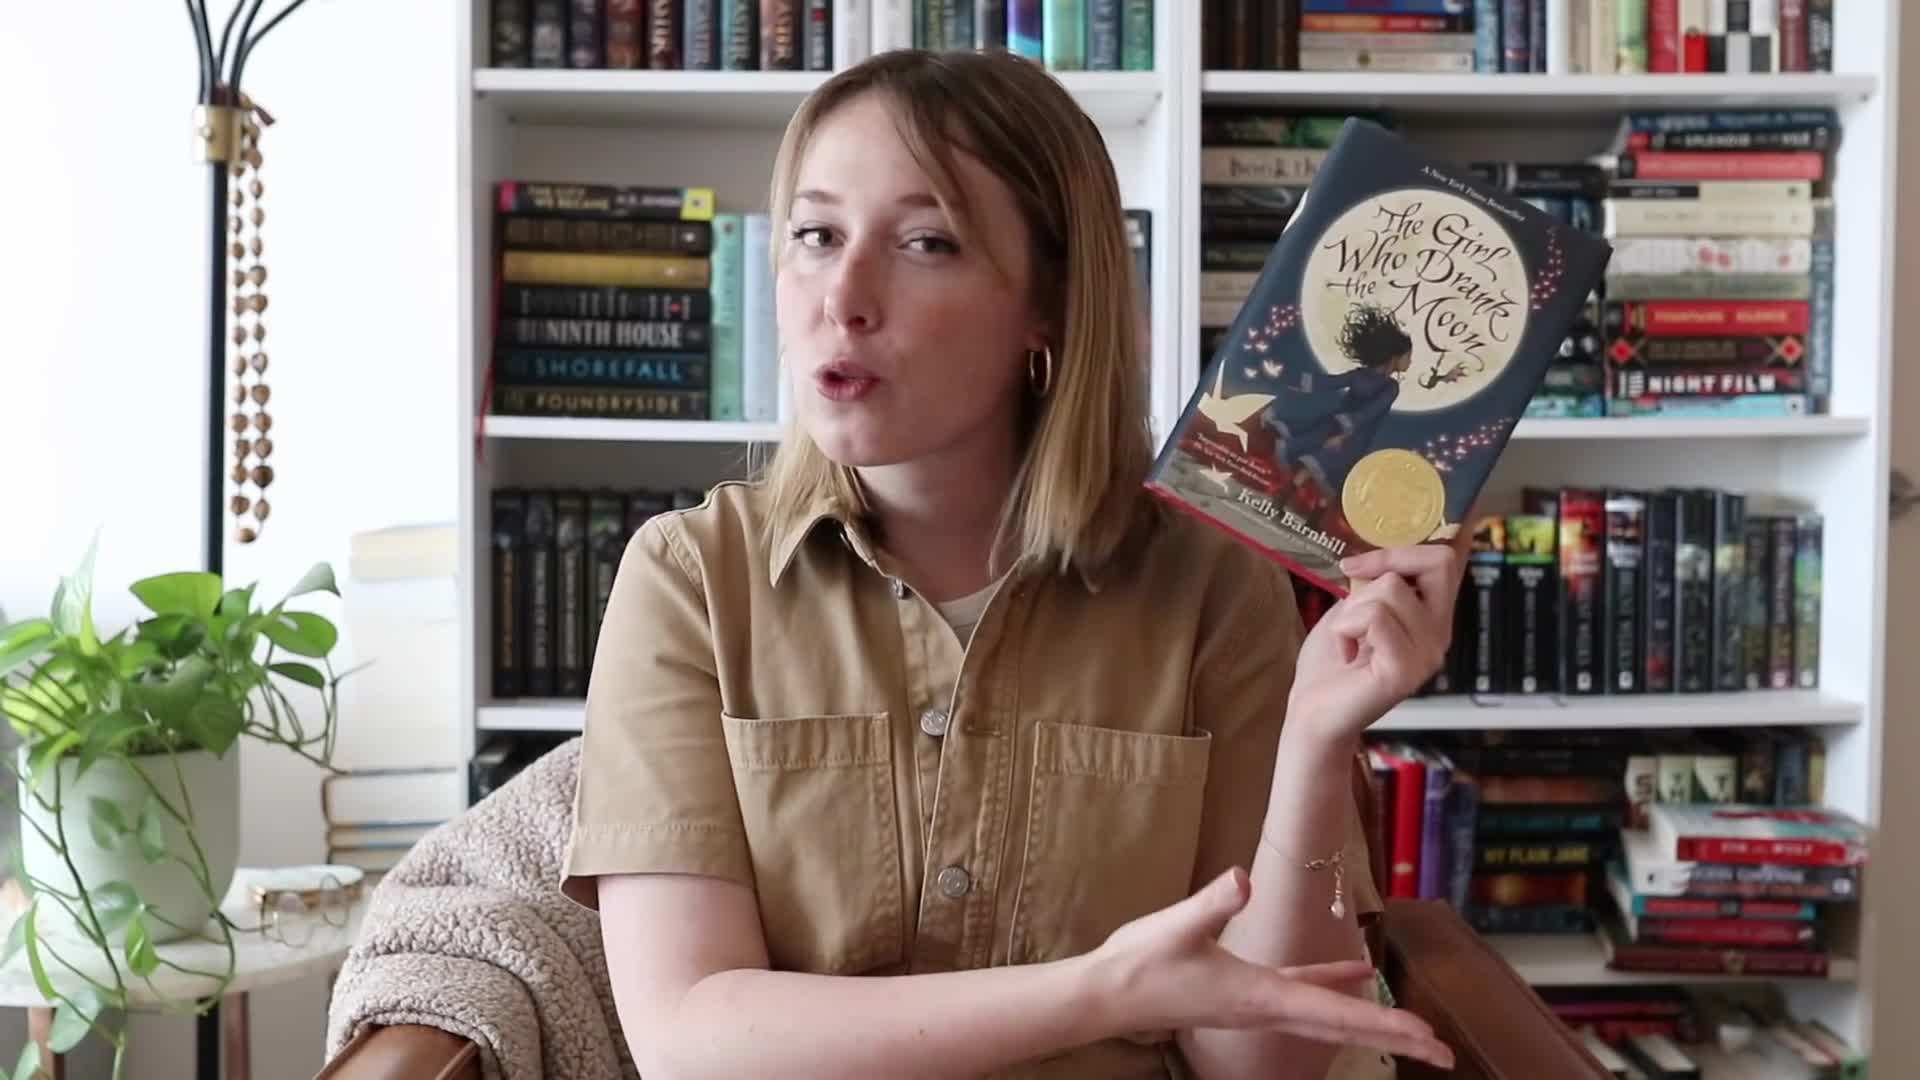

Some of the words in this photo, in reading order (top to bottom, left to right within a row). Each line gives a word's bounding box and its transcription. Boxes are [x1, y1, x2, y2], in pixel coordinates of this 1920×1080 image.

[1373, 202, 1424, 240] The
[1432, 213, 1511, 282] Girl
[1323, 230, 1407, 276] Who
[1416, 248, 1520, 342] Drank
[547, 320, 610, 345] NINTH
[615, 321, 682, 347] HOUSE
[1326, 271, 1377, 299] the
[1388, 280, 1486, 372] Moon
[535, 357, 682, 380] SHOREFALL
[1649, 374, 1716, 393] NIGHT
[1720, 374, 1776, 393] FILM
[536, 392, 681, 413] FOUNDRYSIDE
[1238, 488, 1280, 520] Kelly
[1281, 511, 1347, 555] Barnhill
